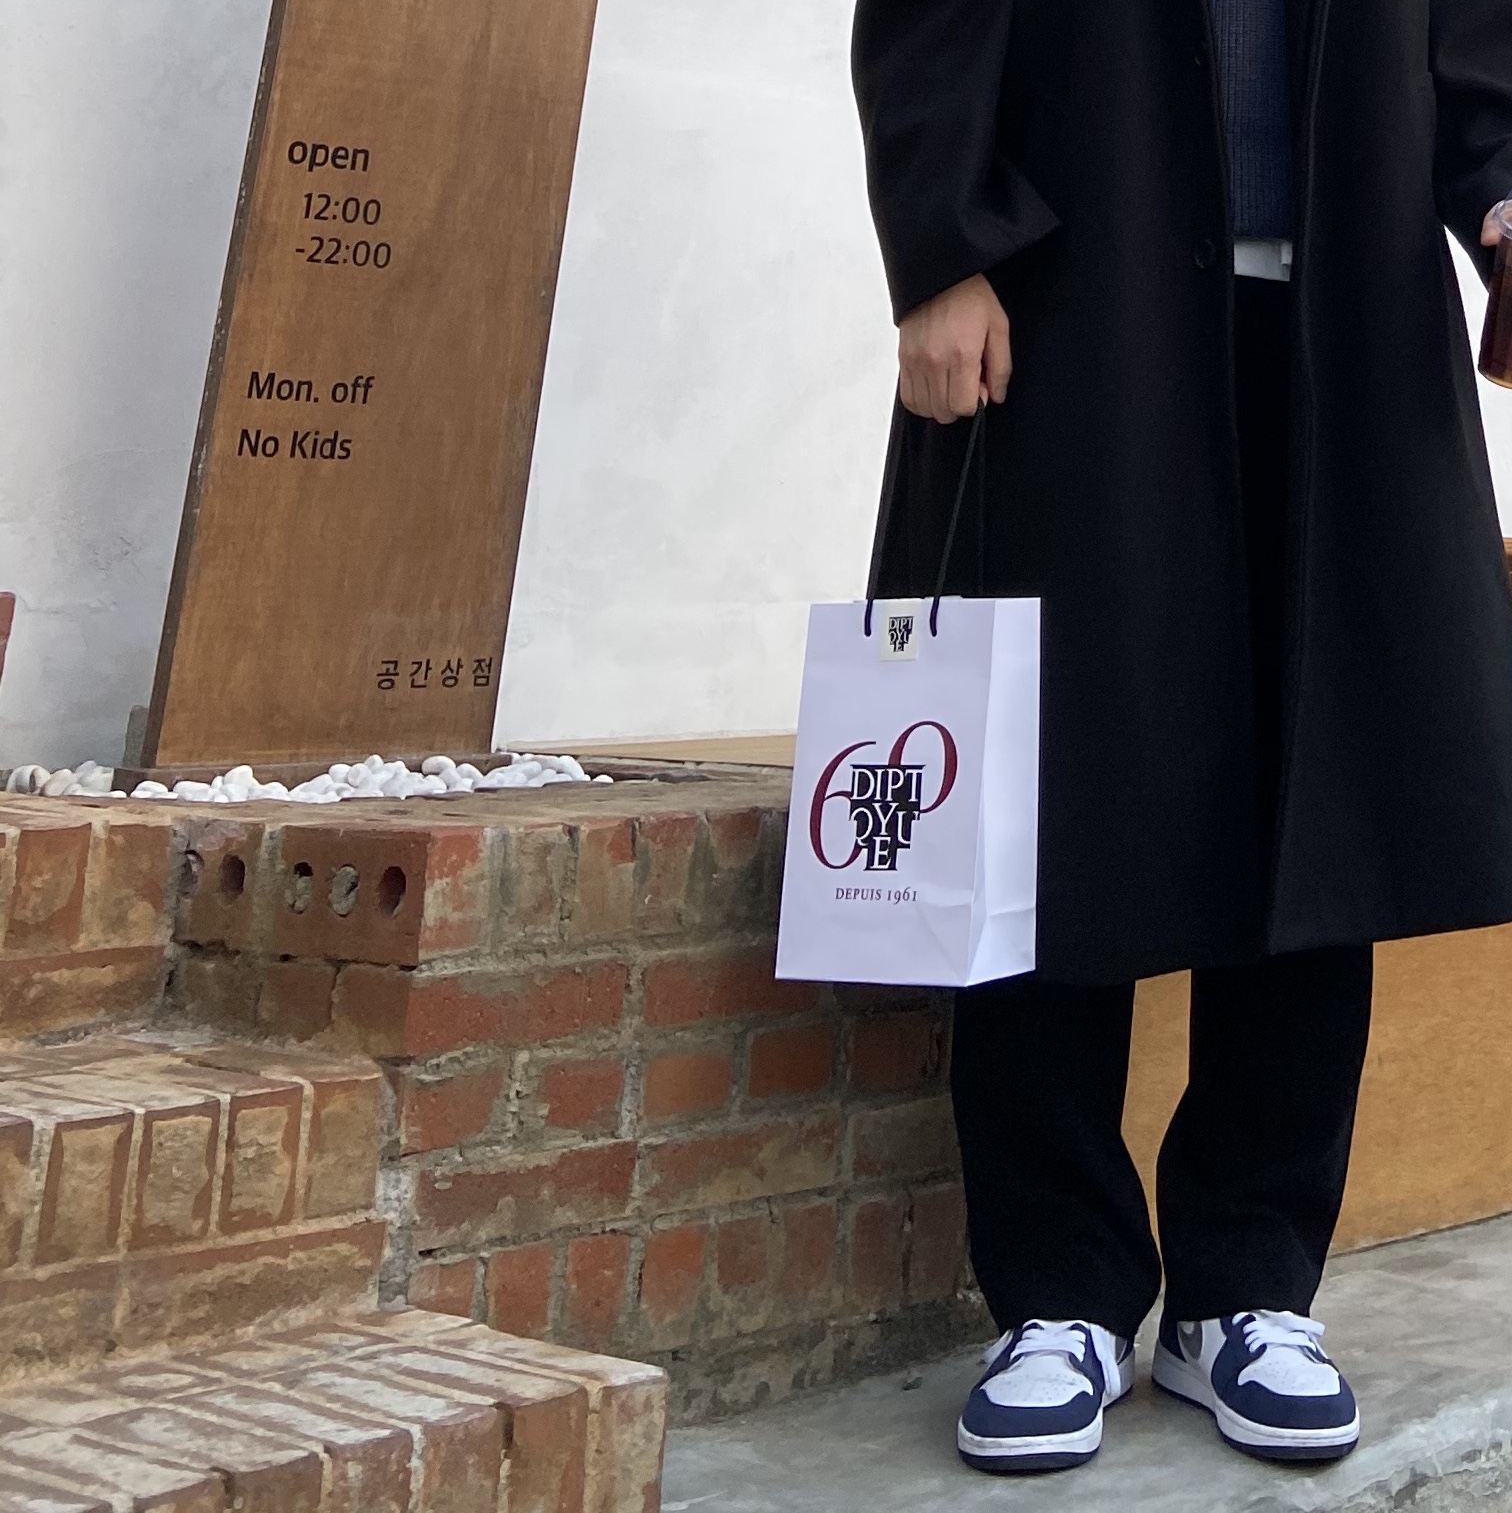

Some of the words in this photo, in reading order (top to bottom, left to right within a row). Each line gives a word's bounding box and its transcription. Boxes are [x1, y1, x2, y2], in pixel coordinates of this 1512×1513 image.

[287, 140, 371, 172] open
[302, 192, 382, 226] 12:00
[295, 236, 392, 269] -22:00
[246, 371, 320, 403] Mon.
[331, 375, 375, 405] off
[237, 429, 279, 458] No
[289, 430, 352, 460] Kids
[376, 657, 494, 690] 공간상점
[835, 887, 882, 901] DEPUIS
[886, 886, 918, 905] 1961
